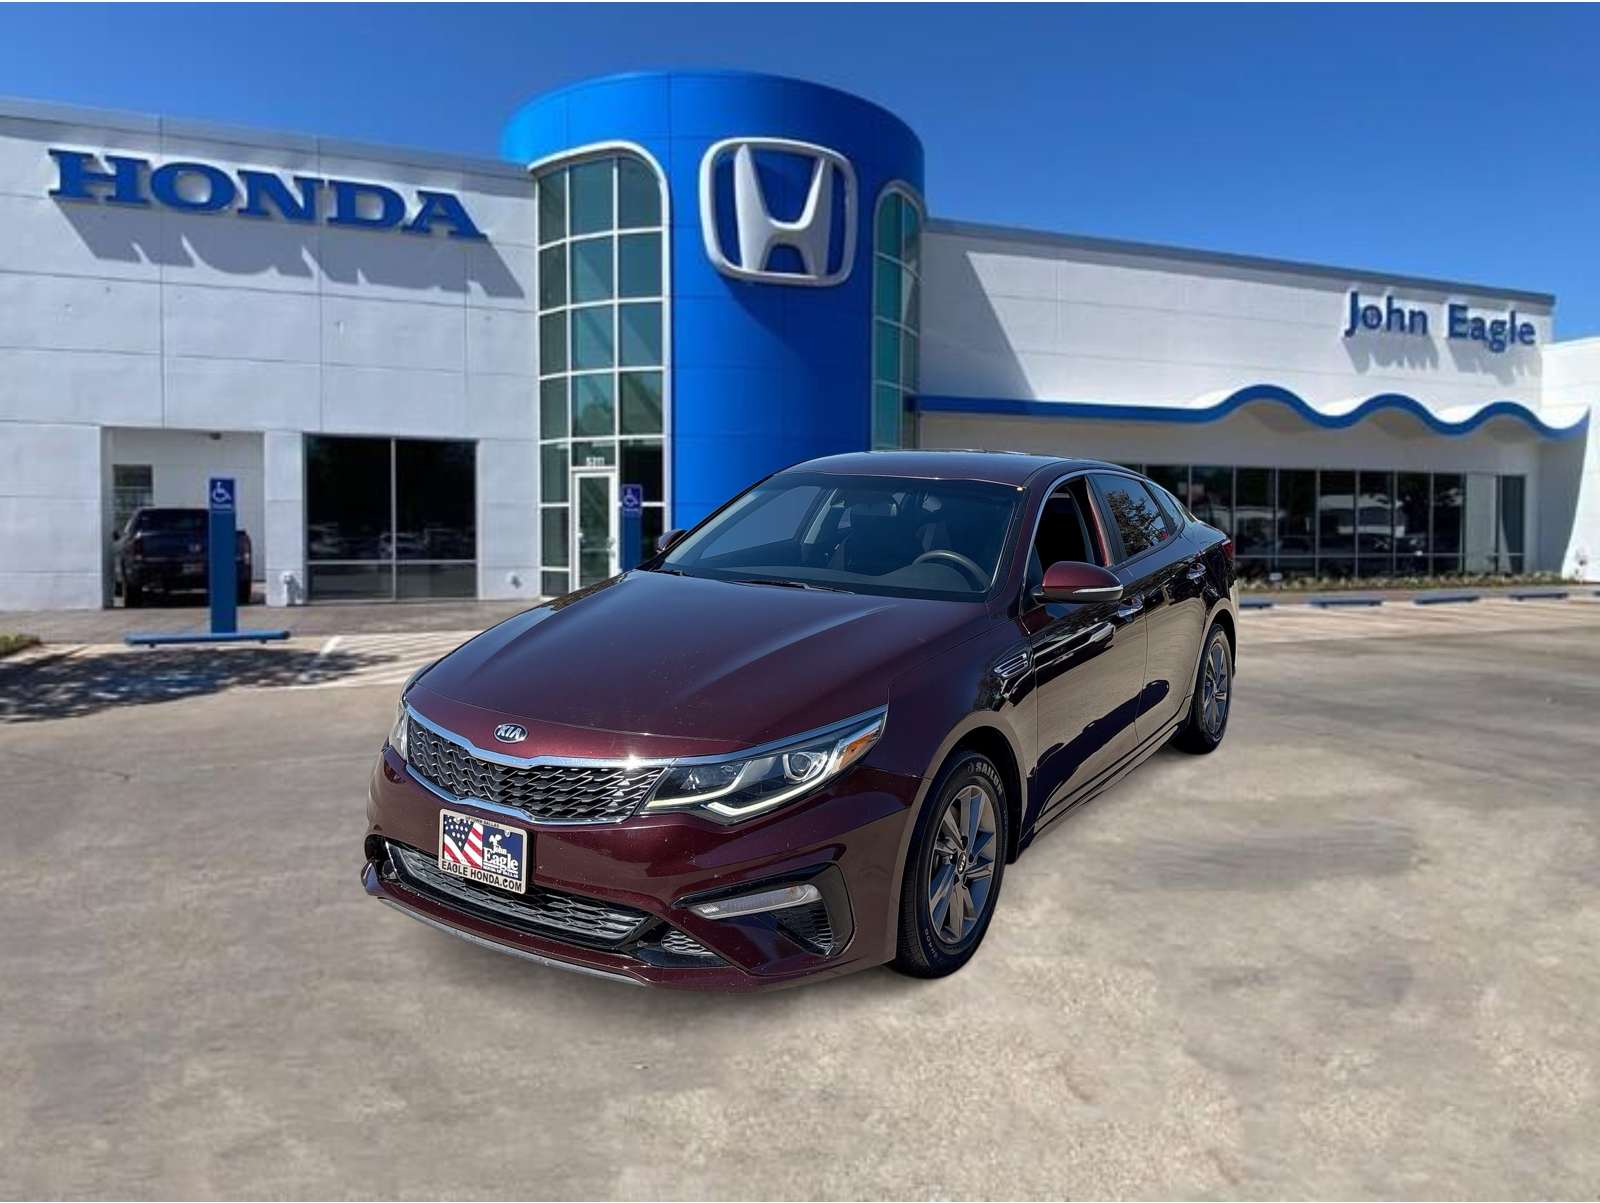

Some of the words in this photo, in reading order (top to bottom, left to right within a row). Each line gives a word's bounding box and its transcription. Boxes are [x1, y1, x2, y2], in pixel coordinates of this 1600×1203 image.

[48, 148, 487, 240] HONDA
[1344, 291, 1428, 338] John
[1448, 303, 1536, 354] Eagle
[496, 725, 522, 740] KIA
[483, 847, 519, 872] Eagle
[441, 860, 468, 877] EAGLE
[470, 869, 522, 892] HONDA.COM
